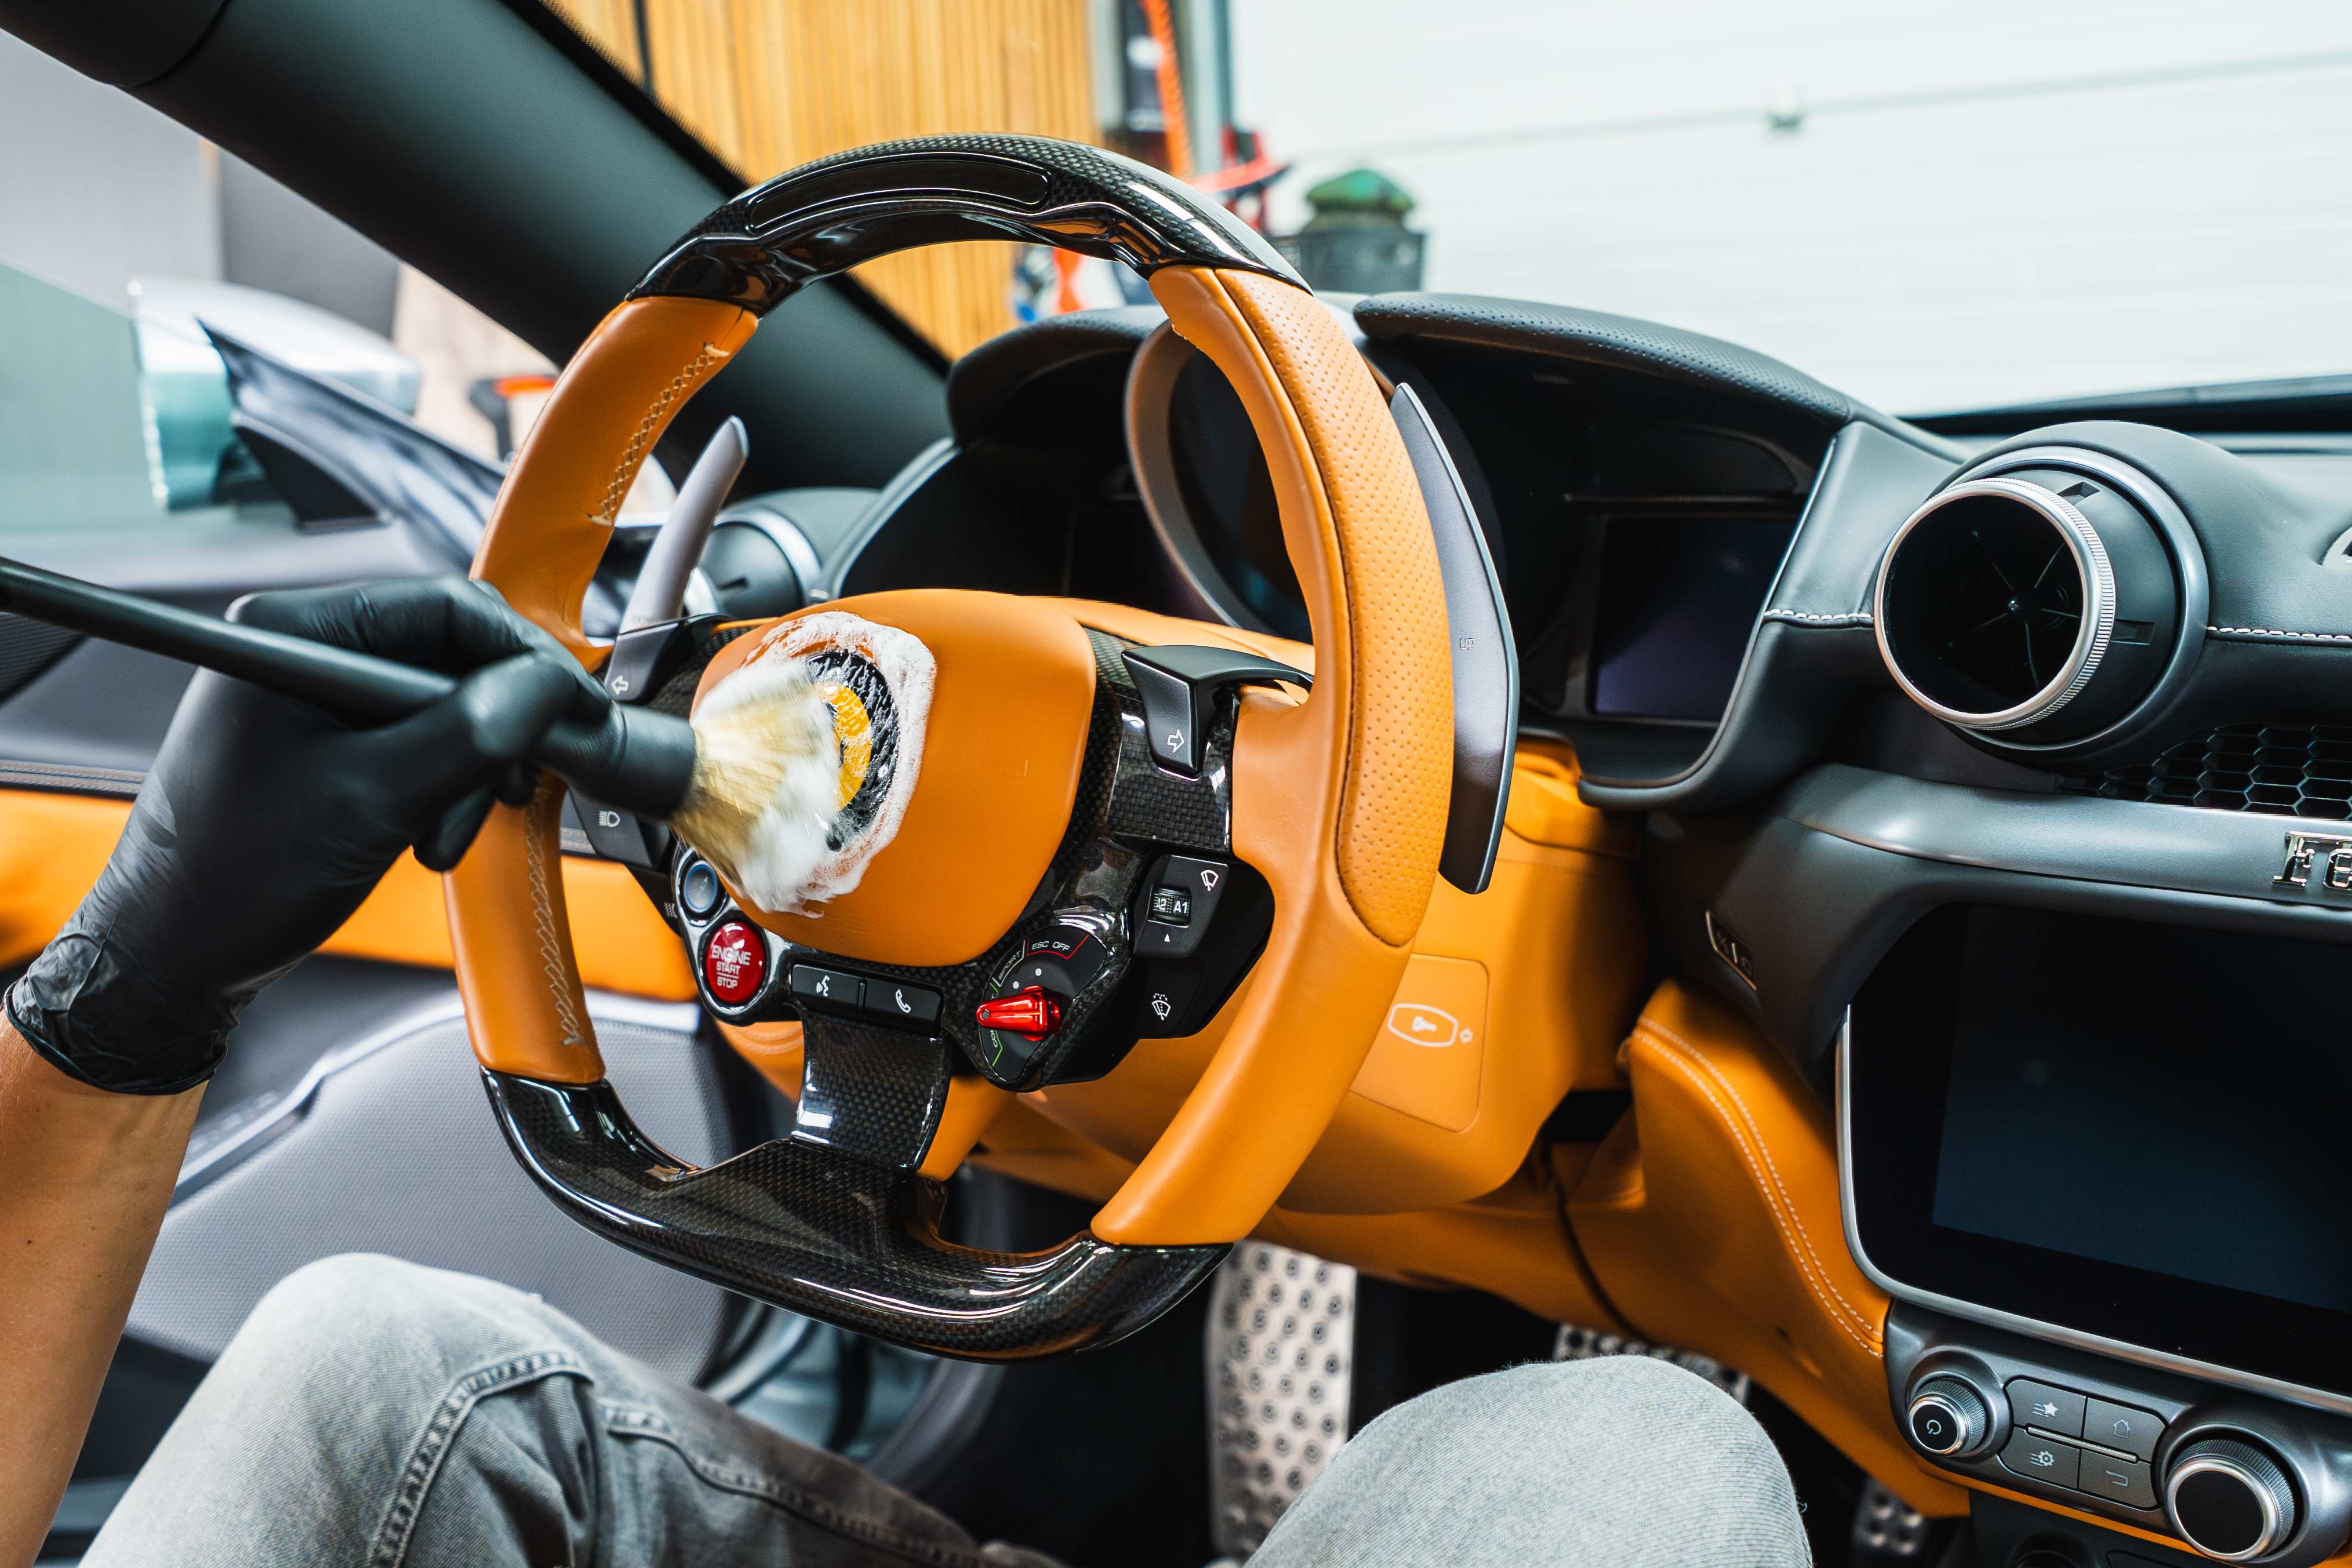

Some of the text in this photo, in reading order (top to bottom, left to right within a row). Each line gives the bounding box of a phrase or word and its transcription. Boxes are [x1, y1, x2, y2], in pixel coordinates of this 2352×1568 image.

[1459, 638, 1475, 650] UP
[1173, 900, 1188, 914] A1
[1031, 941, 1070, 951] ESC OFF
[711, 944, 751, 966] ENGINE
[716, 961, 741, 974] START
[998, 950, 1021, 980] SPORT
[717, 976, 737, 989] STOP
